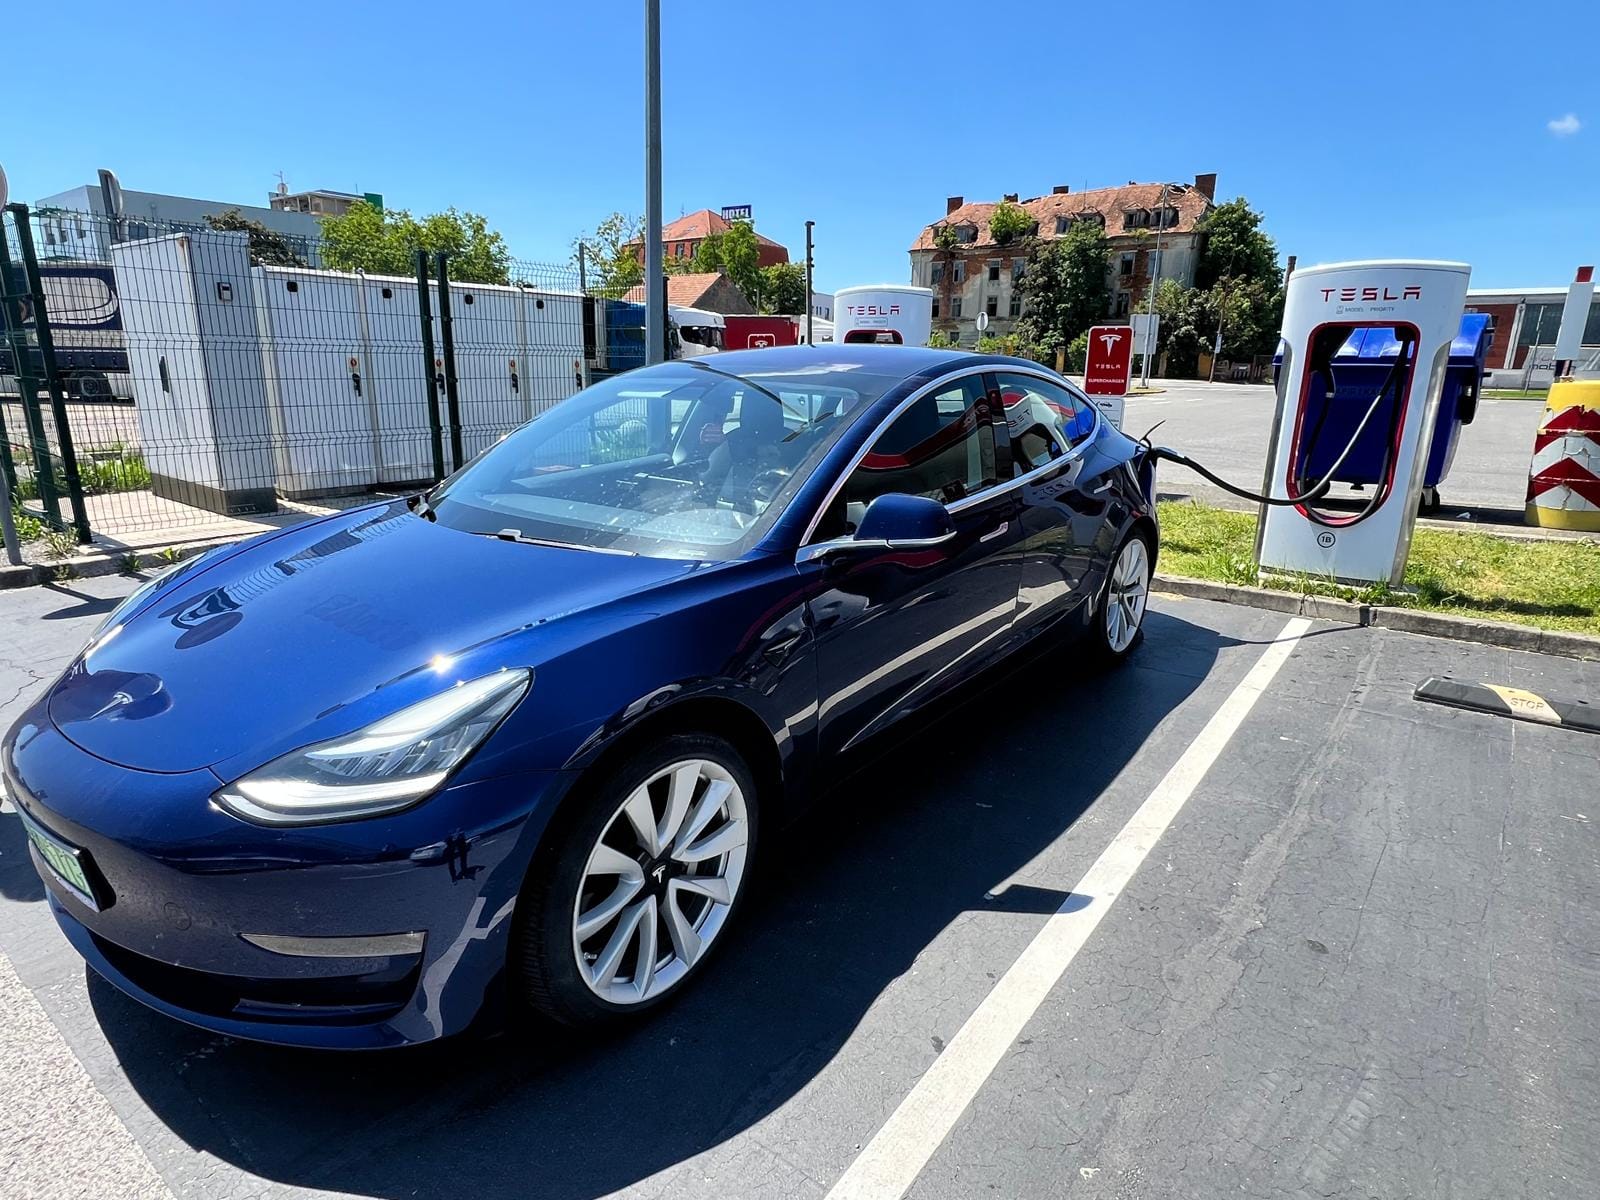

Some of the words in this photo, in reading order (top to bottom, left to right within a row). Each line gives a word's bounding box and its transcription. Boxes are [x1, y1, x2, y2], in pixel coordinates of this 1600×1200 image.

[722, 208, 749, 220] HOTEL
[1320, 286, 1422, 302] TESLA
[847, 305, 900, 316] TESLA
[1510, 697, 1544, 710] STOP
